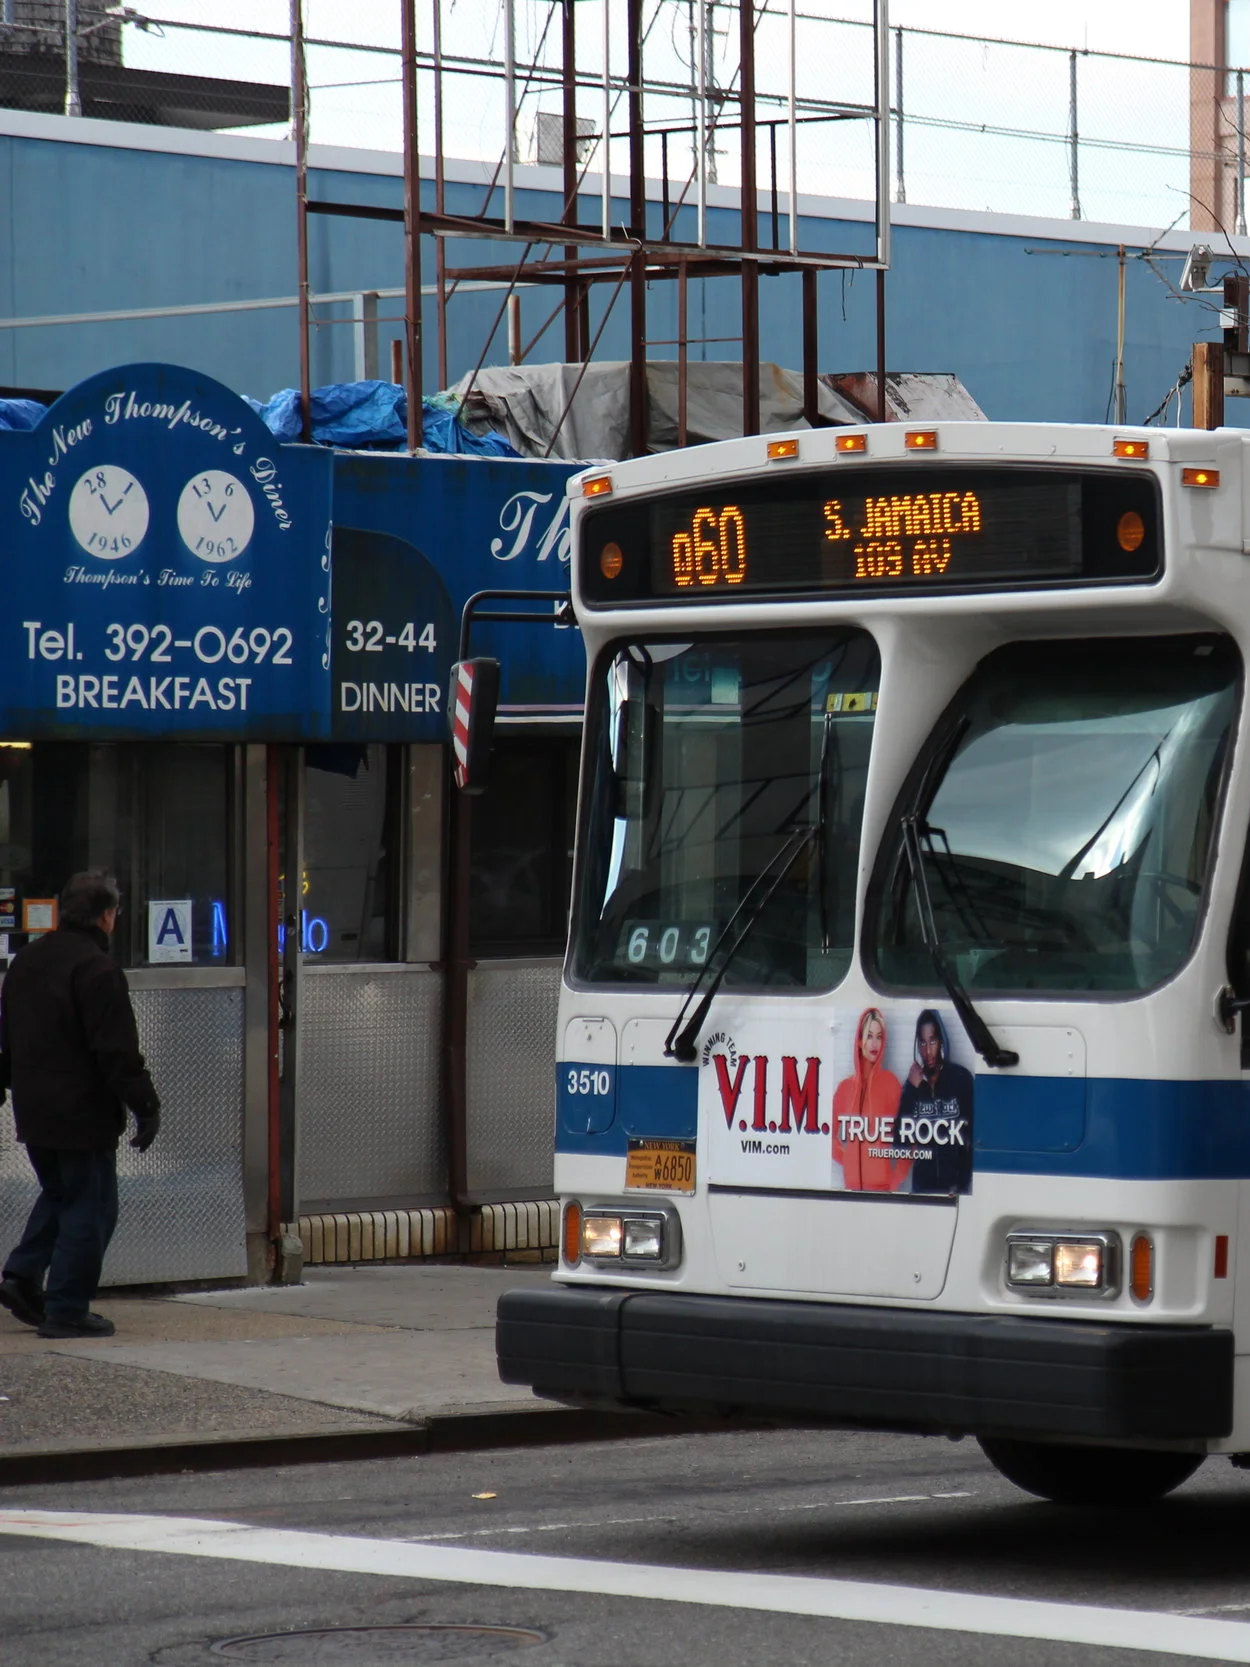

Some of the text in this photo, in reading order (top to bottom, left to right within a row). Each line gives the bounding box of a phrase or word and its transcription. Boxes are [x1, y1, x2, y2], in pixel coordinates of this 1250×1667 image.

[20, 391, 293, 531] The New Thompson's Diner
[84, 471, 107, 495] 28
[191, 478, 236, 499] 13 6
[824, 491, 980, 540] S. JAMAICA
[87, 532, 132, 553] 1946
[195, 536, 238, 557] 1962
[913, 538, 951, 575] AV
[63, 566, 252, 595] Thompson's Time To Life
[23, 621, 83, 660] Tel.
[345, 620, 437, 653] 32-44
[56, 674, 252, 711] BREAKFAST
[340, 682, 441, 713] DINNER
[156, 908, 185, 945] A
[628, 927, 711, 964] 603
[703, 1032, 738, 1067] WINNING TEAM
[567, 1070, 610, 1096] 3510
[712, 1054, 830, 1135] V.I.M.
[838, 1115, 965, 1146] TRUE ROCK
[741, 1140, 790, 1155] VIM.com
[868, 1148, 932, 1160] TRUEROCK.COM
[663, 1155, 692, 1182] 6850
